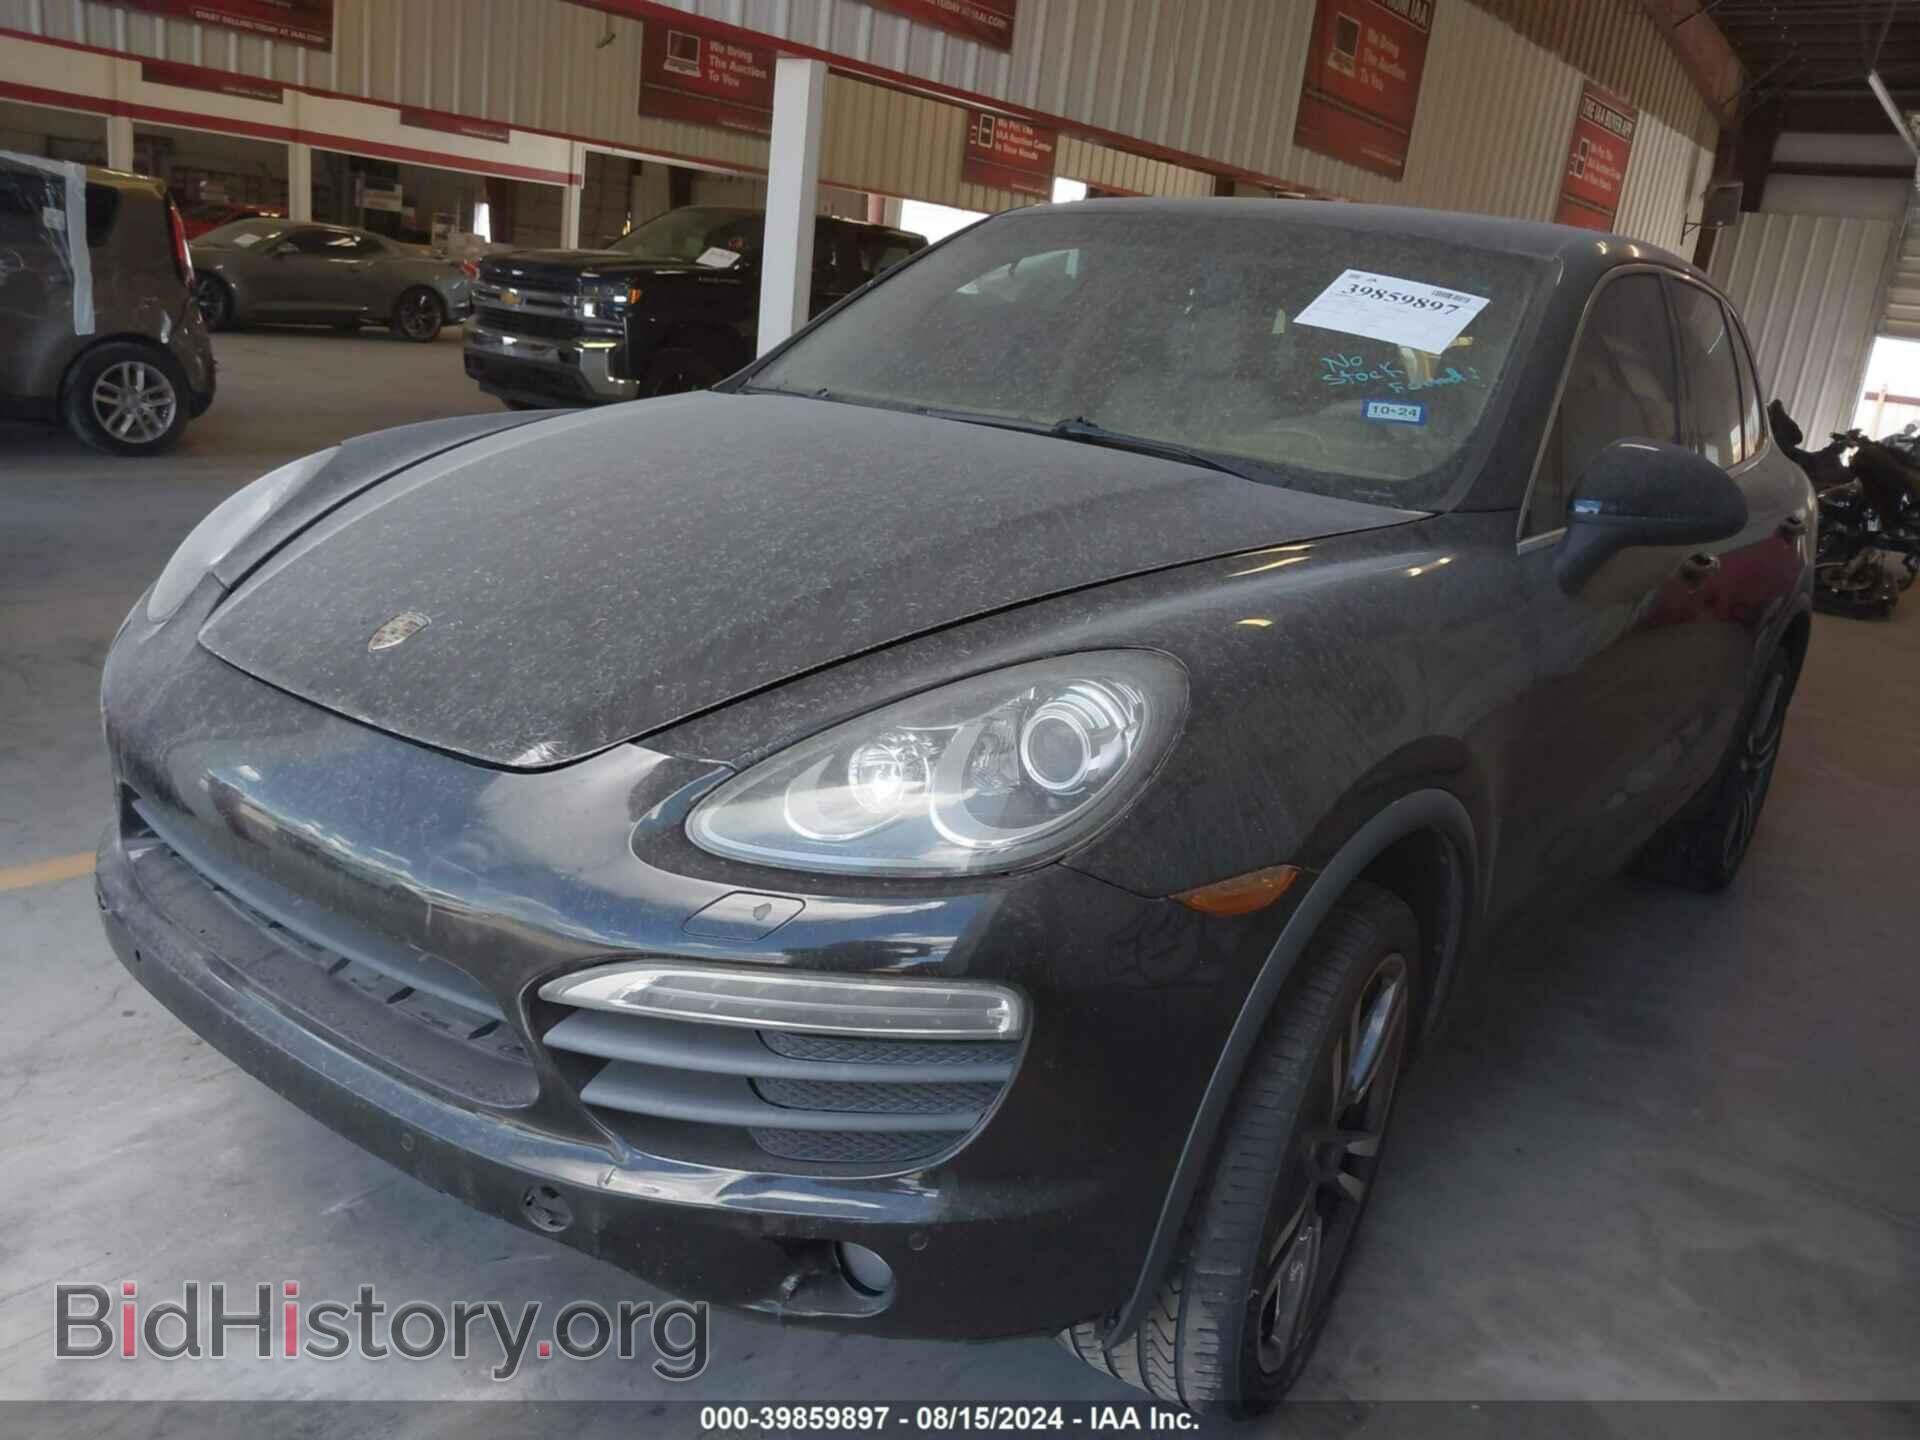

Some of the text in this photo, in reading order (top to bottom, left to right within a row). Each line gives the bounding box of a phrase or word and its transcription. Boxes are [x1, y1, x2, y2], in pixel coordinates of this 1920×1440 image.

[709, 40, 725, 54] We
[709, 54, 768, 79] The Auction
[708, 69, 740, 87] To You
[1341, 283, 1460, 315] 39859897
[1321, 353, 1363, 371] No
[1372, 405, 1417, 418] 10-24
